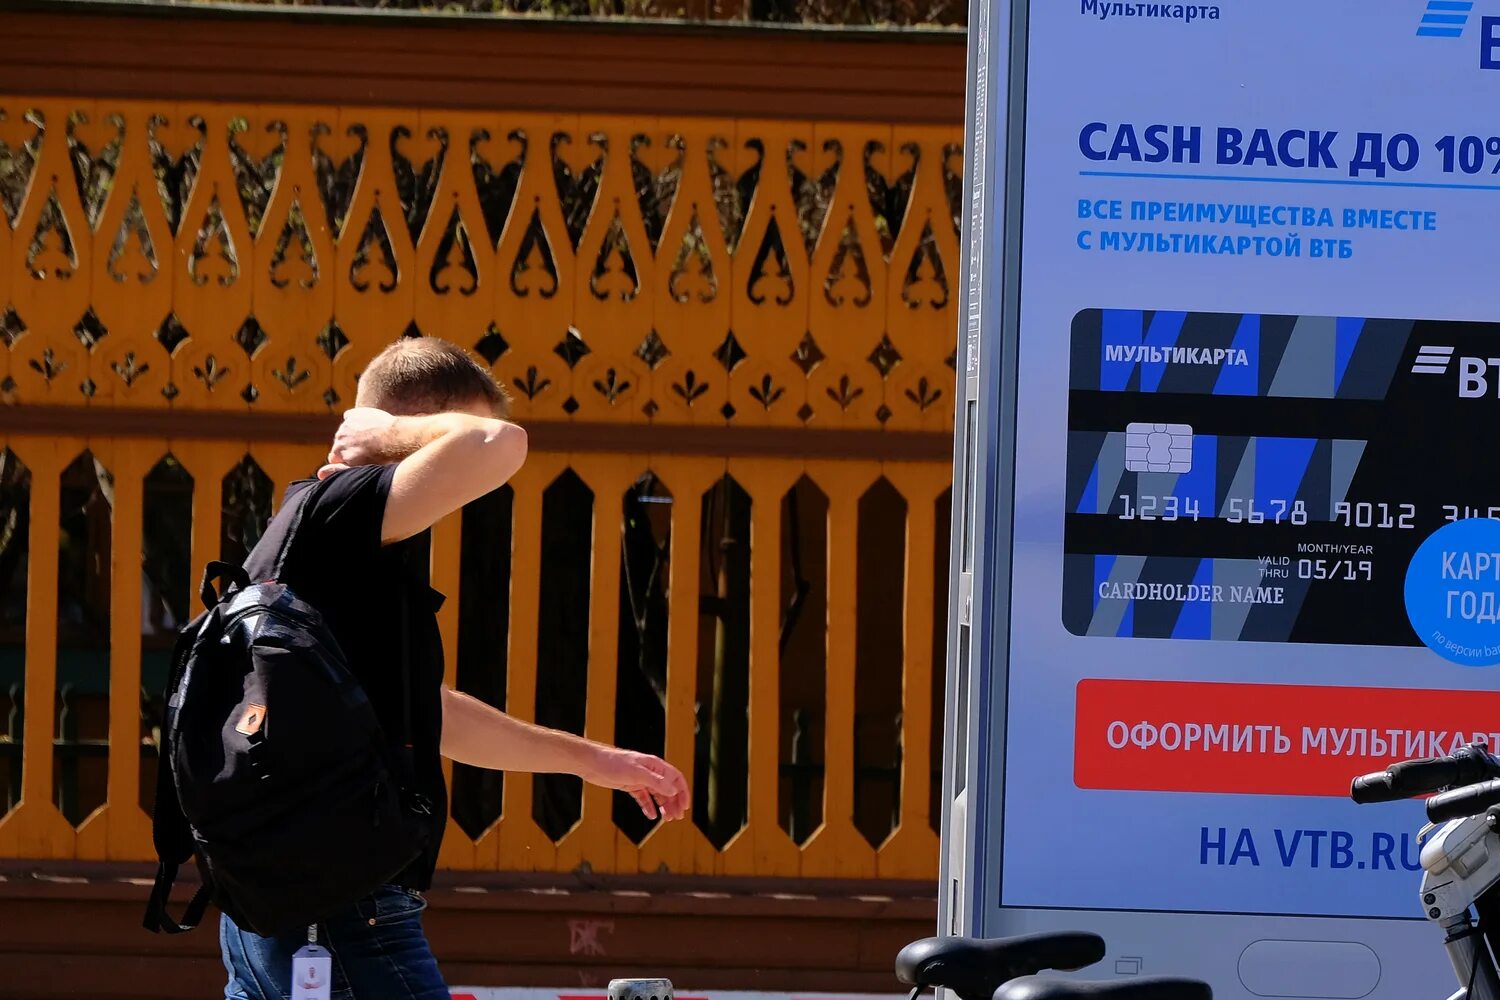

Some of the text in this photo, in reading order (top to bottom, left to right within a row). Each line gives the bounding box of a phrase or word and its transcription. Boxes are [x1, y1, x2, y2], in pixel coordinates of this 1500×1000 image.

[1080, 0, 1220, 23] Мультикарта
[1079, 122, 1201, 163] CASH
[1216, 127, 1338, 168] BACK
[1349, 132, 1420, 178] ДО
[1077, 199, 1437, 231] ВСЕ ПРЕИМУЩЕСТВА ВМЕСТЕ
[1077, 230, 1353, 259] С МУЛЬТИКАРТОЙ ВТБ
[1105, 345, 1249, 367] МУЛЬТИКАРТА
[1118, 494, 1200, 522] 1234
[1226, 498, 1308, 526] 5678
[1334, 502, 1416, 529] 9012
[1258, 556, 1290, 566] VALID
[1297, 543, 1374, 555] MONTH/YEAR
[1258, 568, 1289, 578] THRU
[1298, 559, 1372, 581] 05/19
[1099, 581, 1284, 605] CARDHOLDER NAME
[1431, 631, 1445, 645] по
[1444, 639, 1482, 658] версии
[1107, 720, 1291, 754] ОФОРМИТЬ
[1200, 827, 1426, 872] НА VTB.RU
